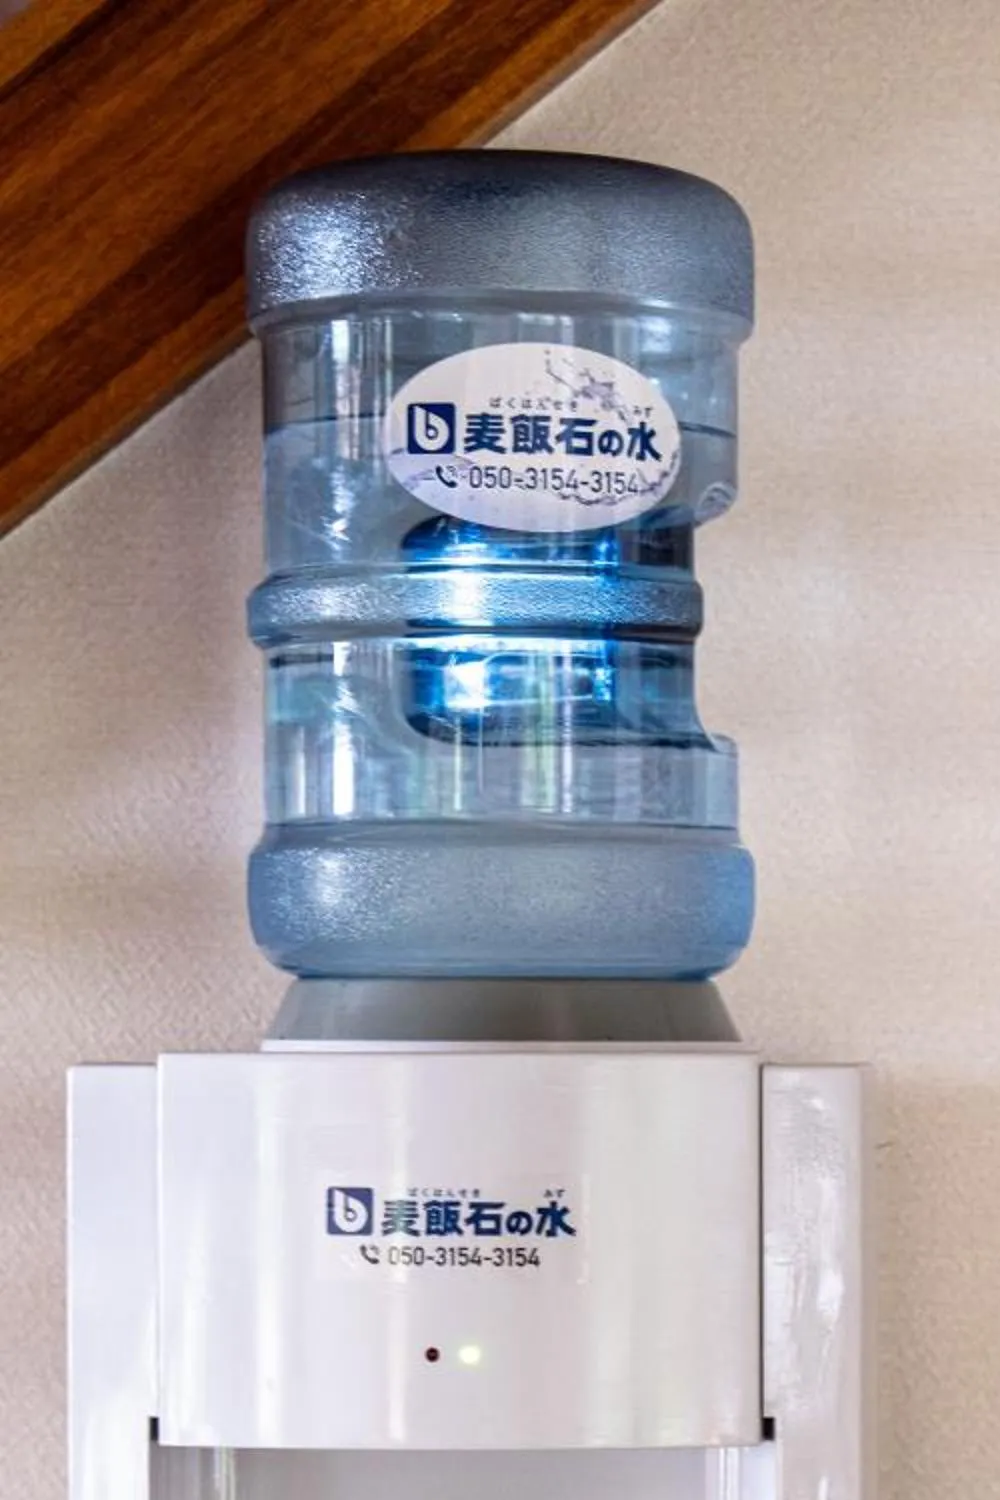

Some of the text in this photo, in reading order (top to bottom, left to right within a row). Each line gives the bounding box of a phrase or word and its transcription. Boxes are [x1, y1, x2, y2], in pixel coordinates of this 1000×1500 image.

[463, 412, 662, 462] 麦飯石の水
[468, 466, 640, 494] 050-3154-3154
[382, 1199, 577, 1237] 麦飯石の水
[388, 1247, 541, 1266] 050-3154-3154
